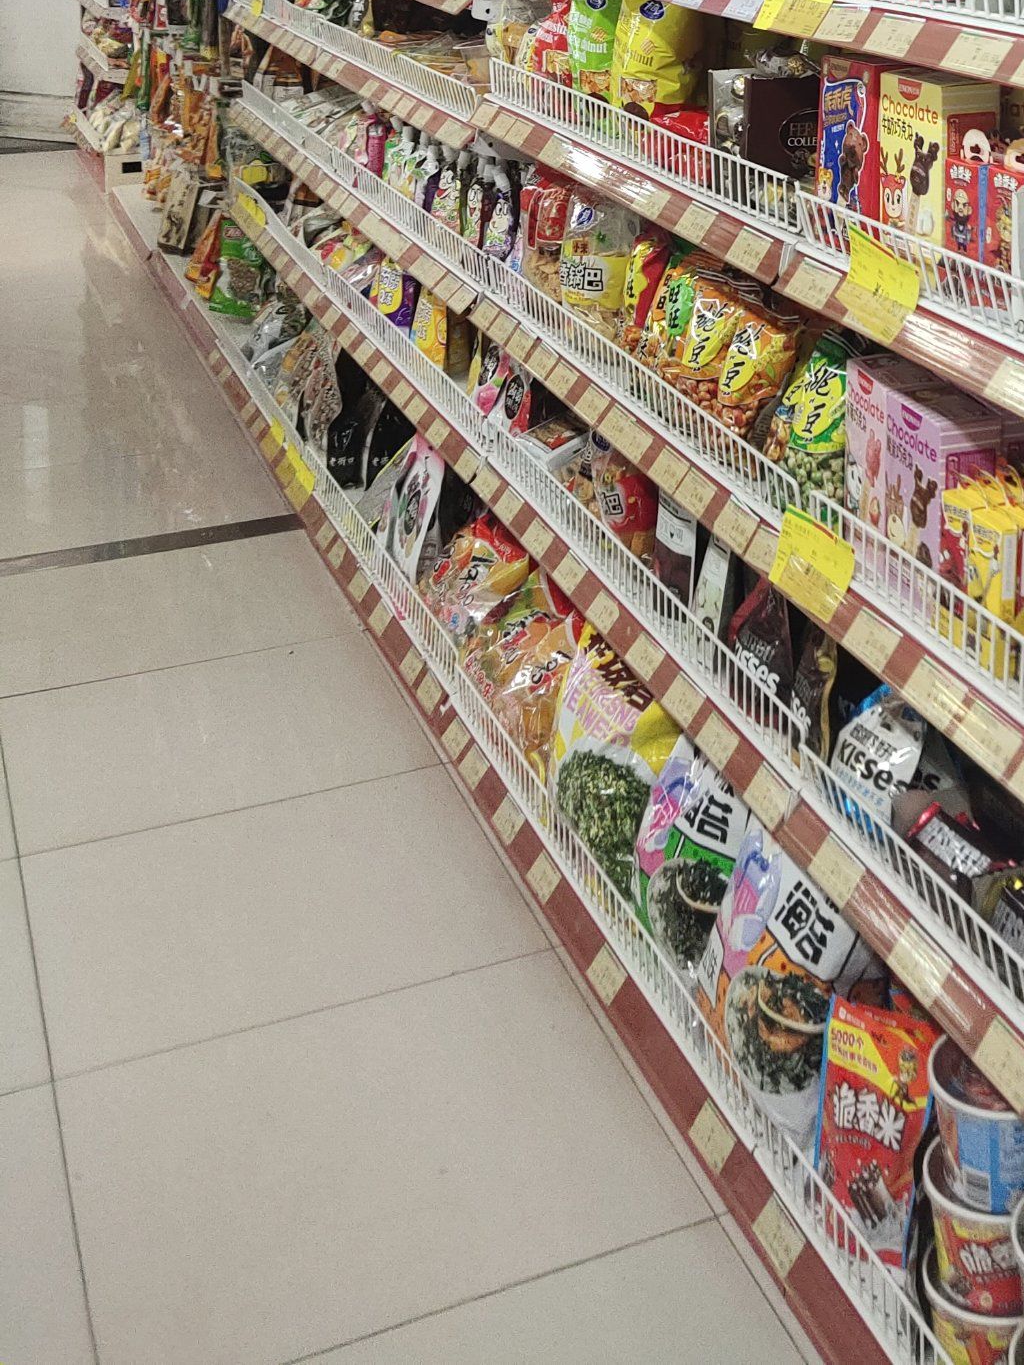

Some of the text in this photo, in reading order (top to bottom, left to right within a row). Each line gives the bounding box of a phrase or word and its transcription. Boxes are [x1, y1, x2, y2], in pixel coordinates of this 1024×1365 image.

[882, 93, 939, 125] Chocolate
[882, 116, 914, 141] 牛奶巧克力
[887, 413, 938, 463] Chocolate
[832, 1080, 906, 1151] 脆香米
